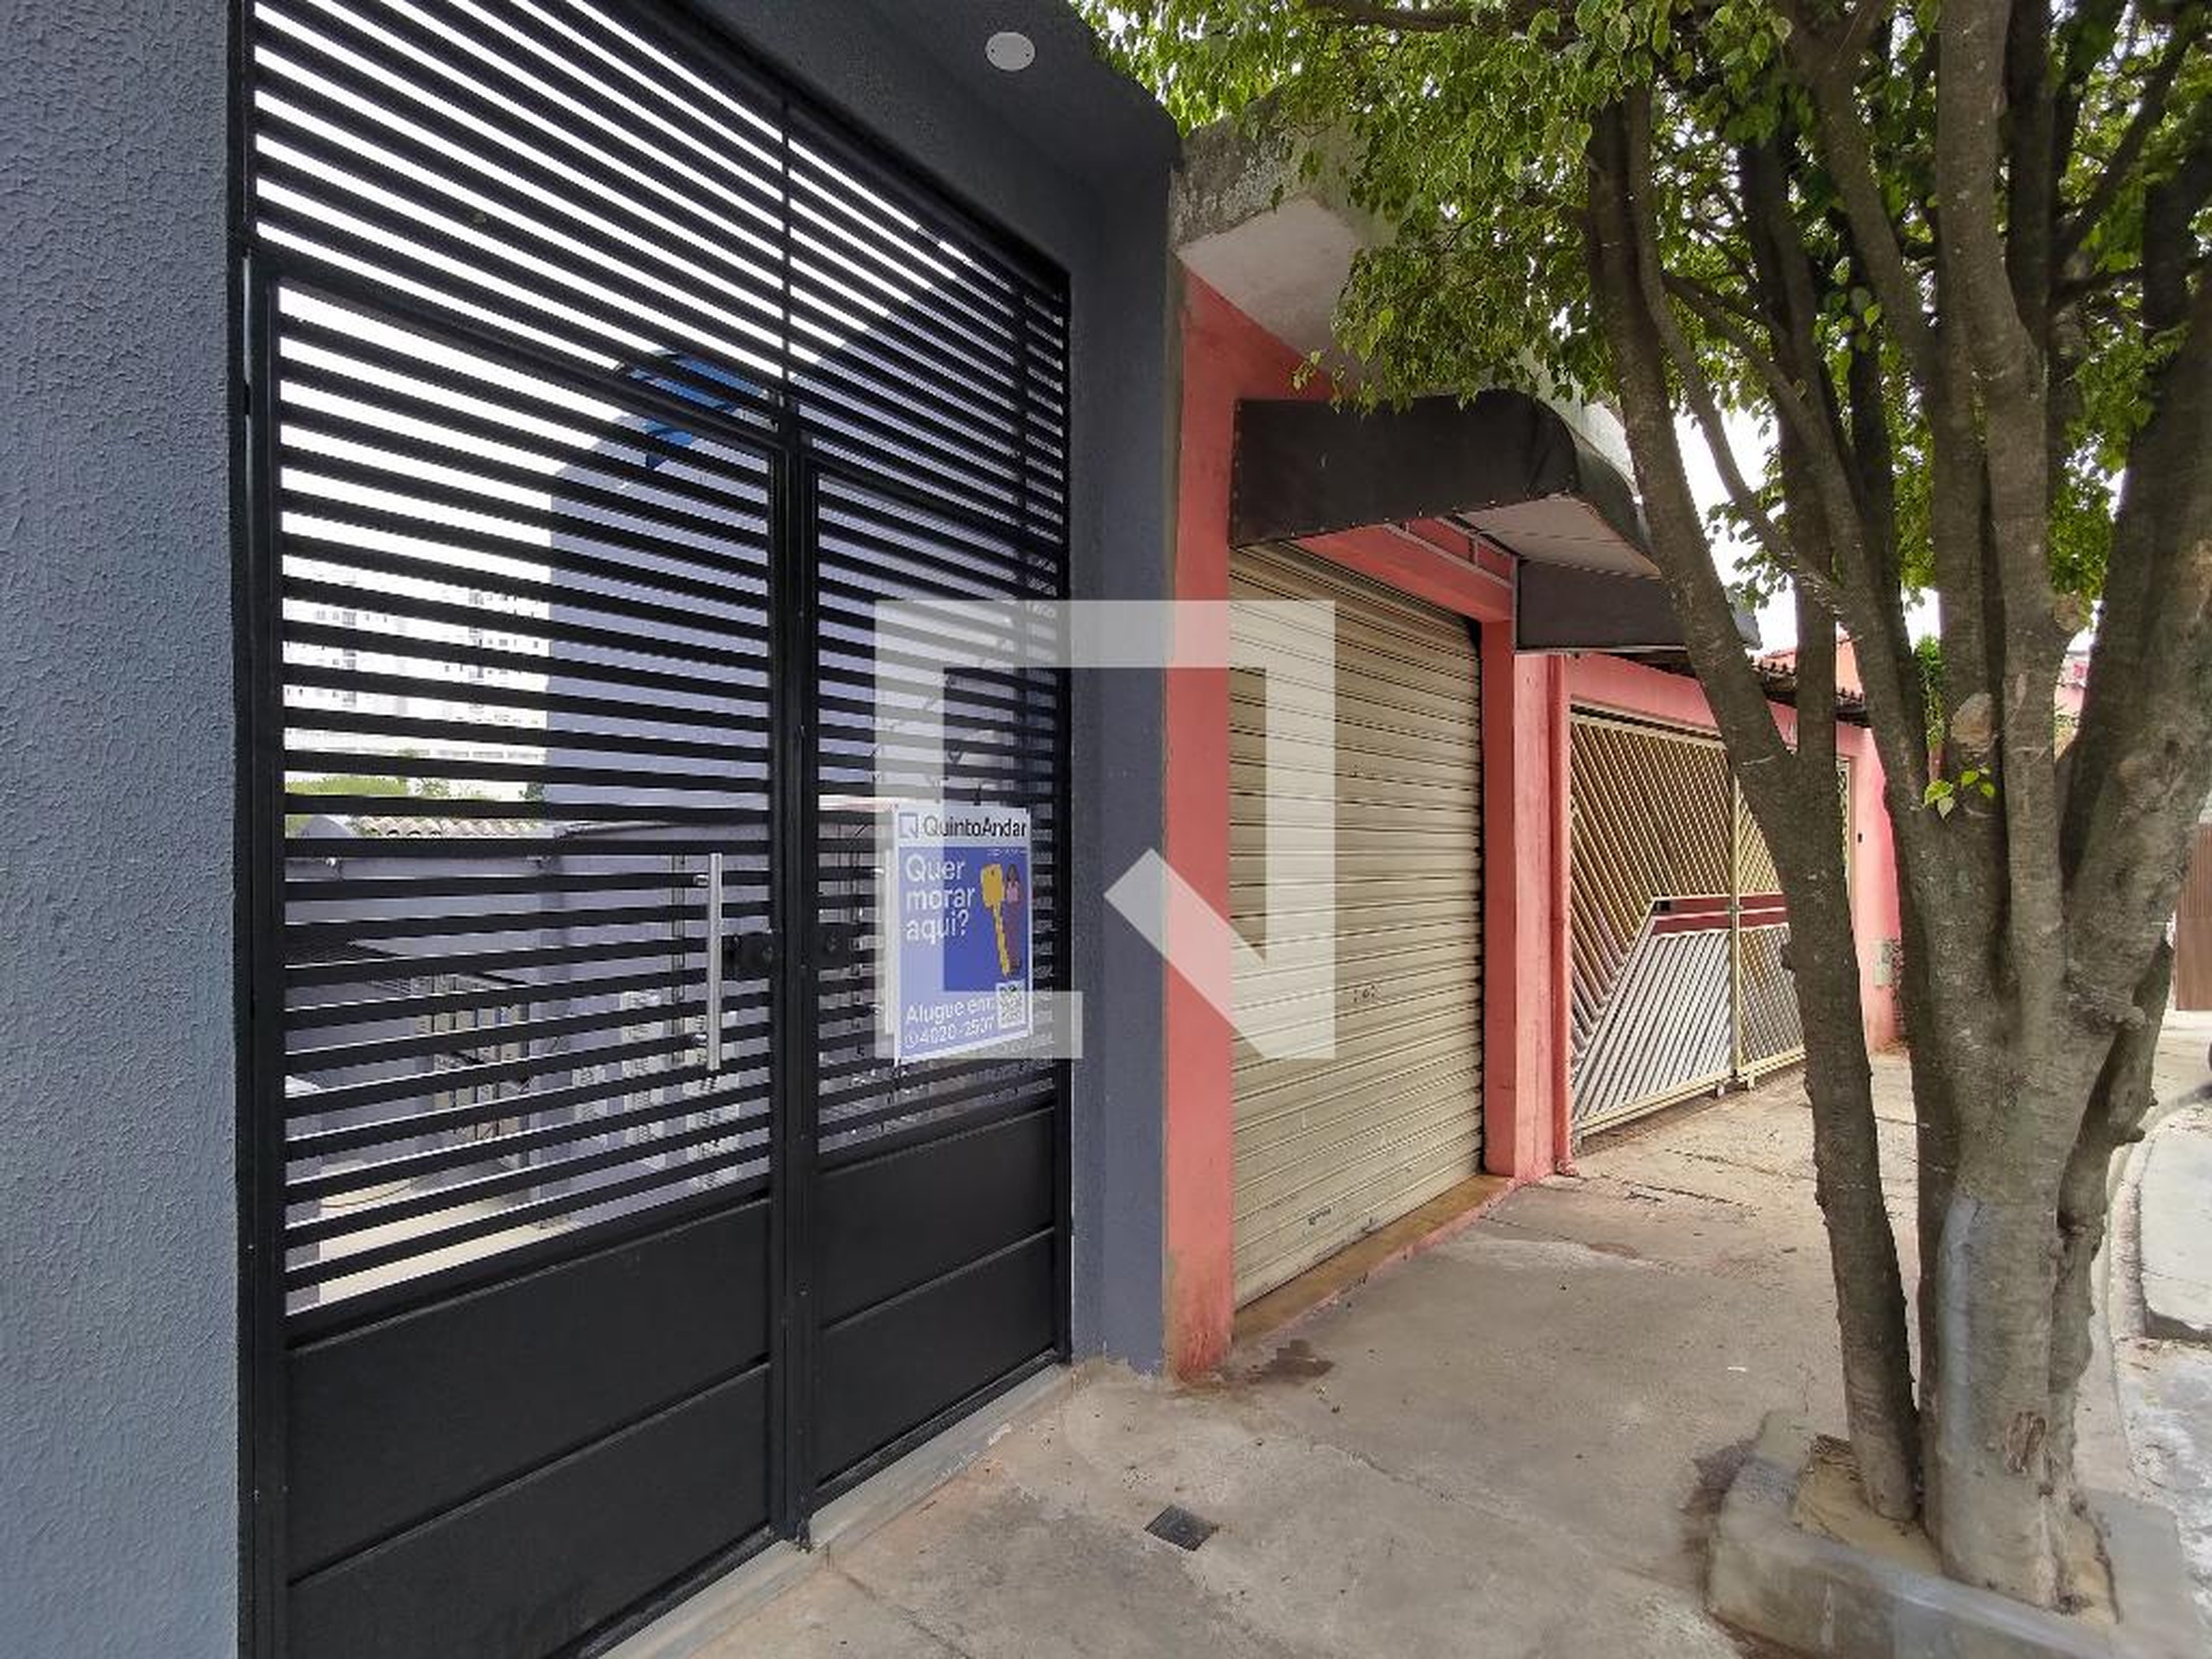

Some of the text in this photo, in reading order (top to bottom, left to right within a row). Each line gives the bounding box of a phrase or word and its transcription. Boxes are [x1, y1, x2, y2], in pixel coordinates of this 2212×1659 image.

[923, 816, 1026, 836] QuintoAndar
[906, 853, 965, 882] Quer
[906, 888, 975, 911] morar
[906, 909, 969, 945] aqui?
[906, 1001, 964, 1025] Alugue
